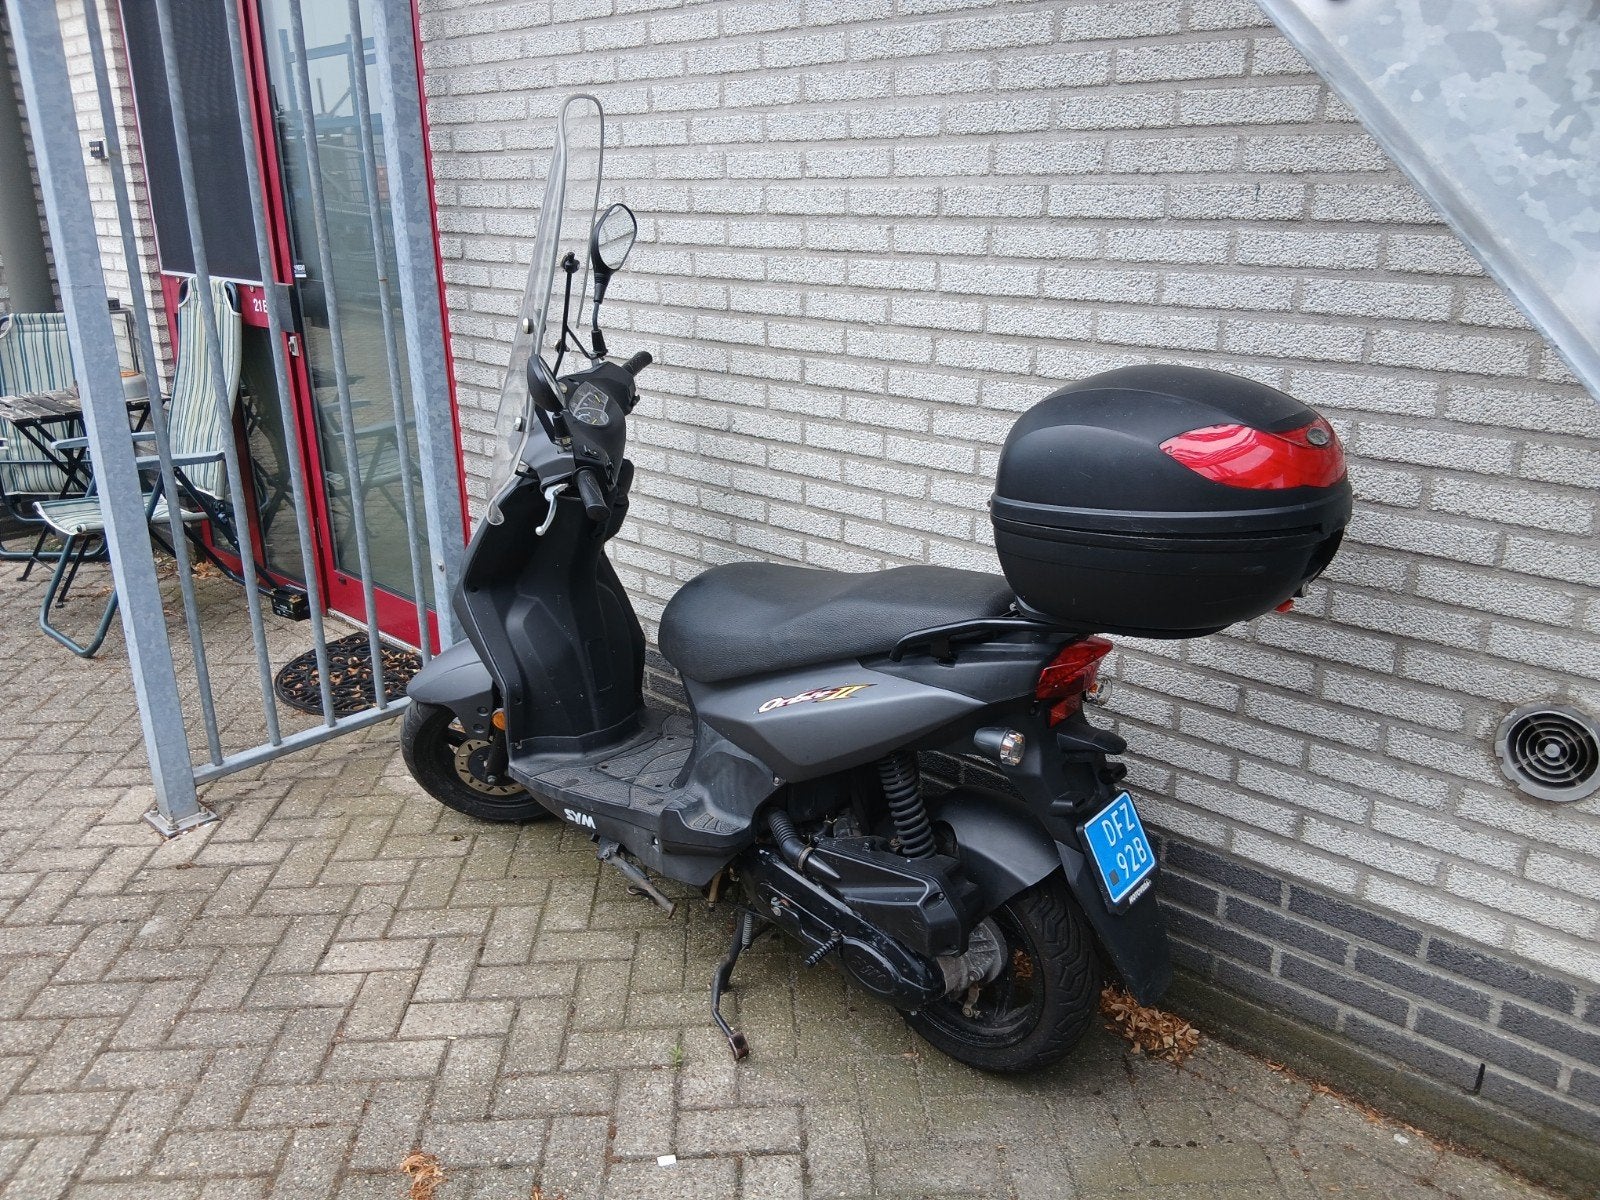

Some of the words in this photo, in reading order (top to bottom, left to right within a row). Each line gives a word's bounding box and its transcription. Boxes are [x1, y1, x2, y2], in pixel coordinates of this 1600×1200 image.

[563, 808, 597, 830] SYM
[1101, 802, 1136, 847] DFZ
[1116, 836, 1147, 880] 92B
